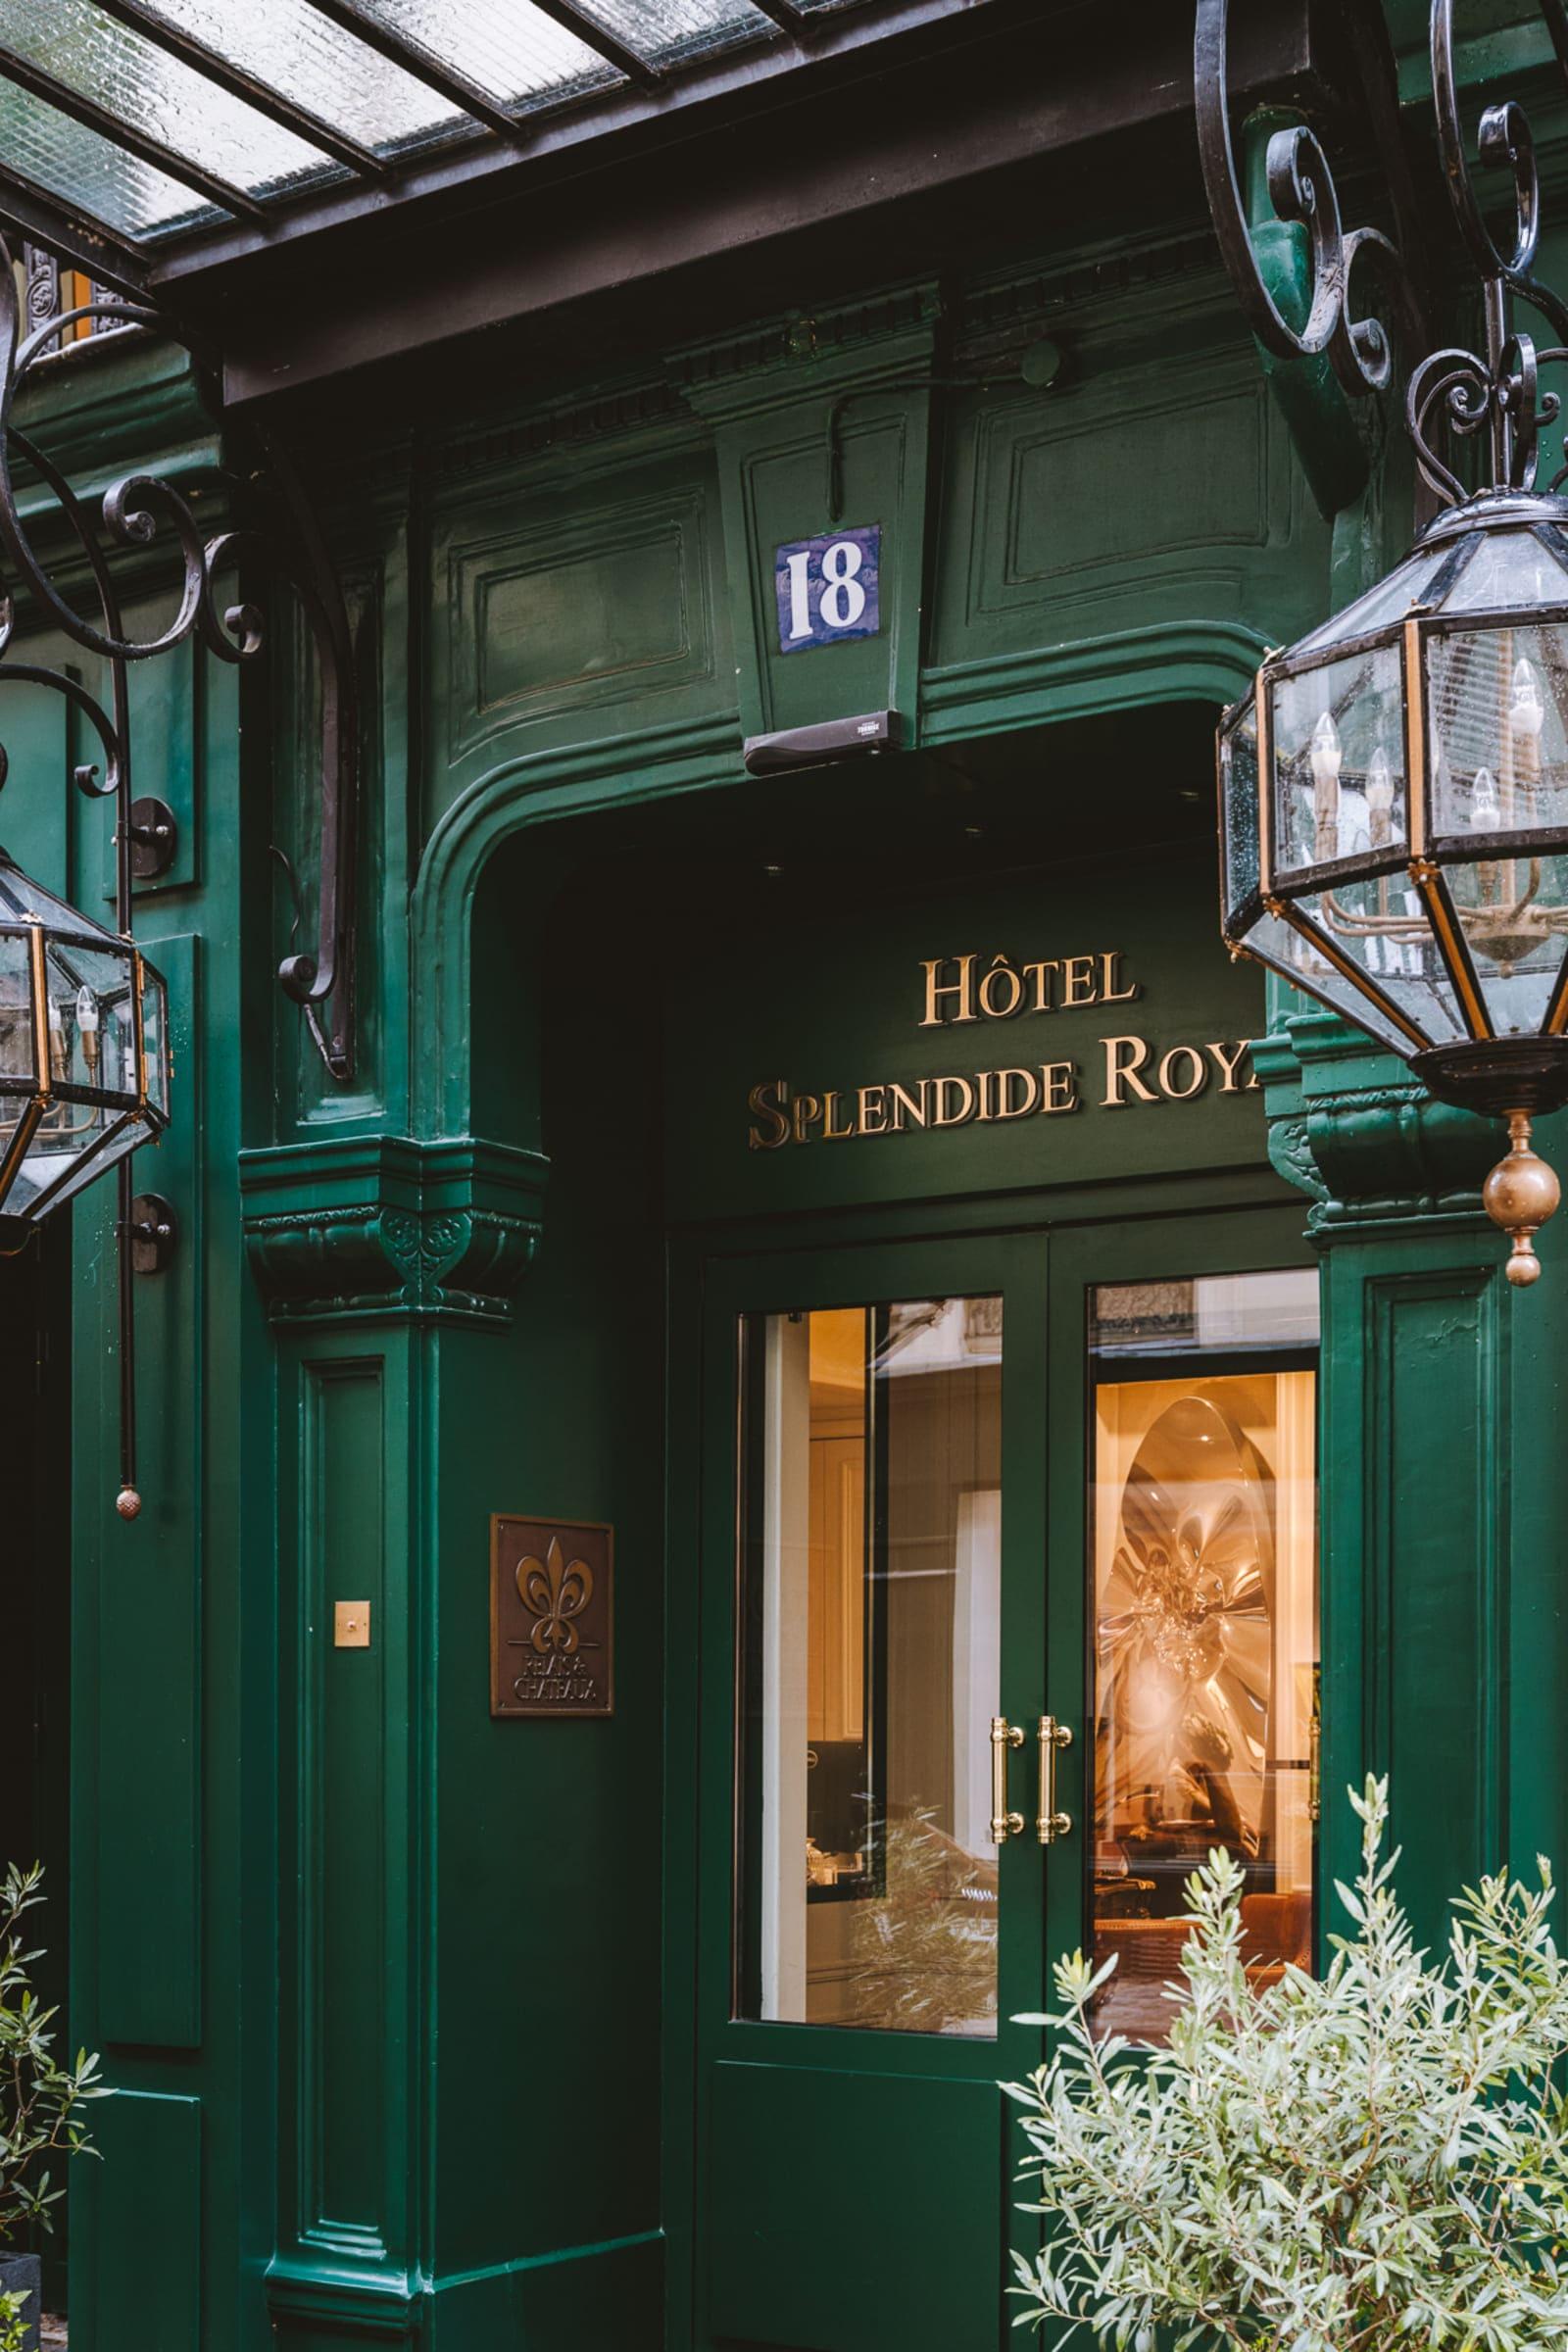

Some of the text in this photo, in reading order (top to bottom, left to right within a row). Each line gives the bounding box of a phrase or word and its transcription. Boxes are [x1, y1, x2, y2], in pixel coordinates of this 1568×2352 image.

[787, 541, 865, 640] 18
[918, 952, 1137, 1027] HÔTEL
[748, 1035, 1260, 1152] SPLENDIDE ROY
